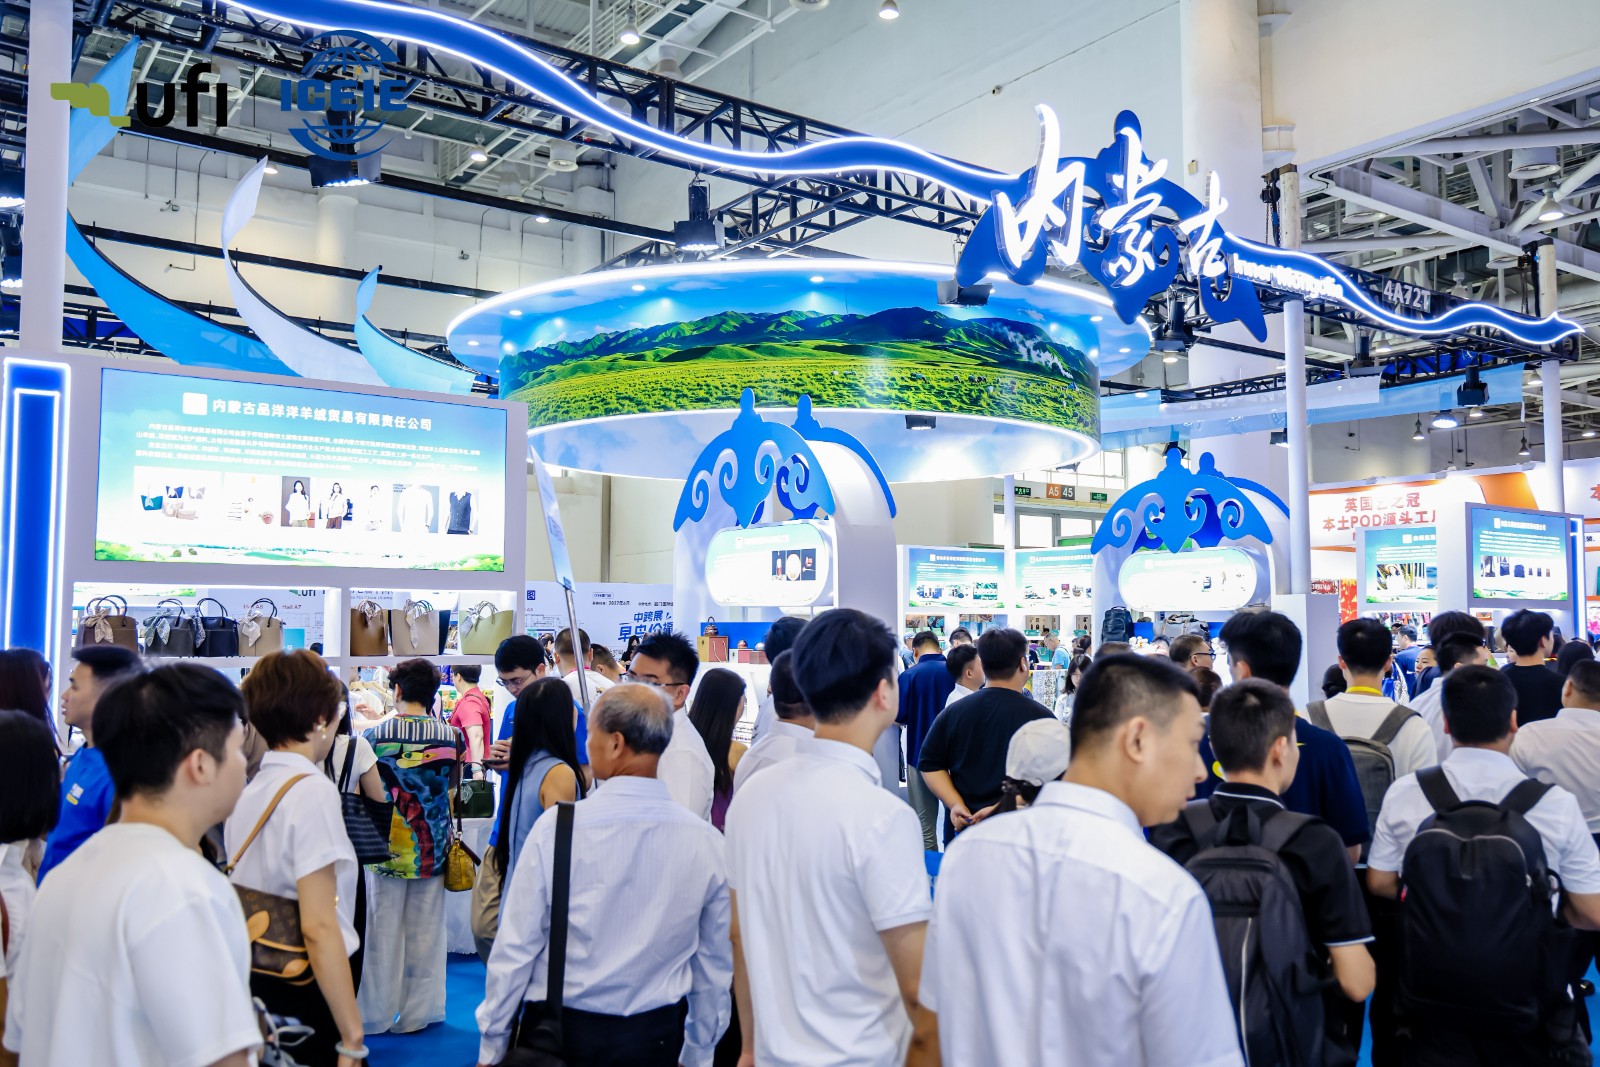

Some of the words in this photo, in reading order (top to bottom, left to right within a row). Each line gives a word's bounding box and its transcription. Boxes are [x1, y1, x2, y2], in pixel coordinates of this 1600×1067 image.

[995, 103, 1228, 287] 内蒙古
[1383, 279, 1430, 311] 4A72T
[212, 397, 433, 432] 内蒙古品洋洋羊绒贸易有限责任公司
[1048, 485, 1059, 497] A5
[1062, 486, 1074, 498] 45
[633, 610, 664, 623] 中跨展
